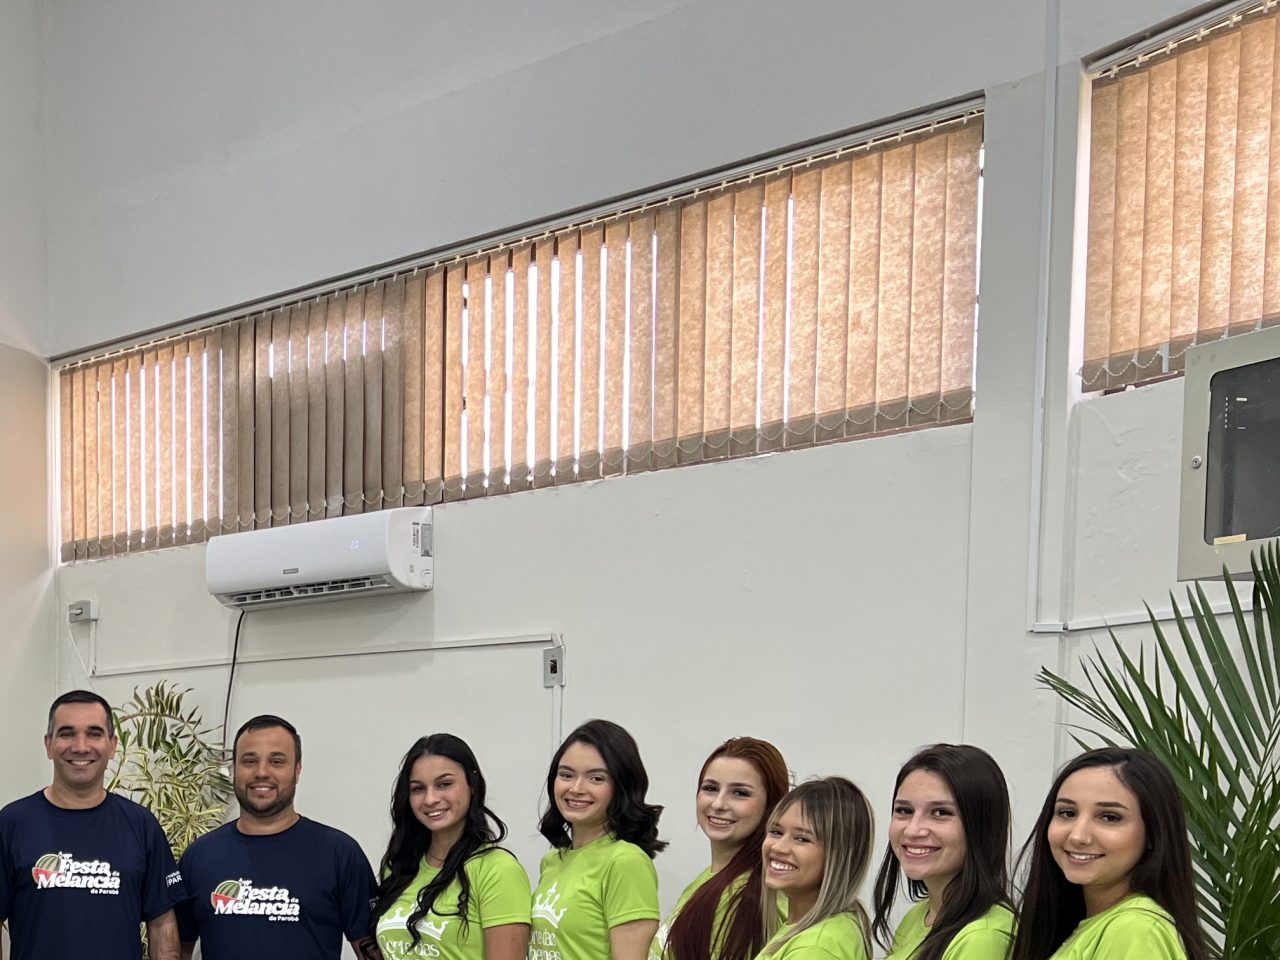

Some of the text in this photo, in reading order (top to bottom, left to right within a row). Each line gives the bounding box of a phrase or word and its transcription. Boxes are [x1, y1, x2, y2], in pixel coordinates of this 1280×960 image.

[59, 859, 111, 877] Festa
[37, 871, 120, 889] Melancia
[237, 886, 289, 903] Festa
[215, 898, 300, 916] Melancia
